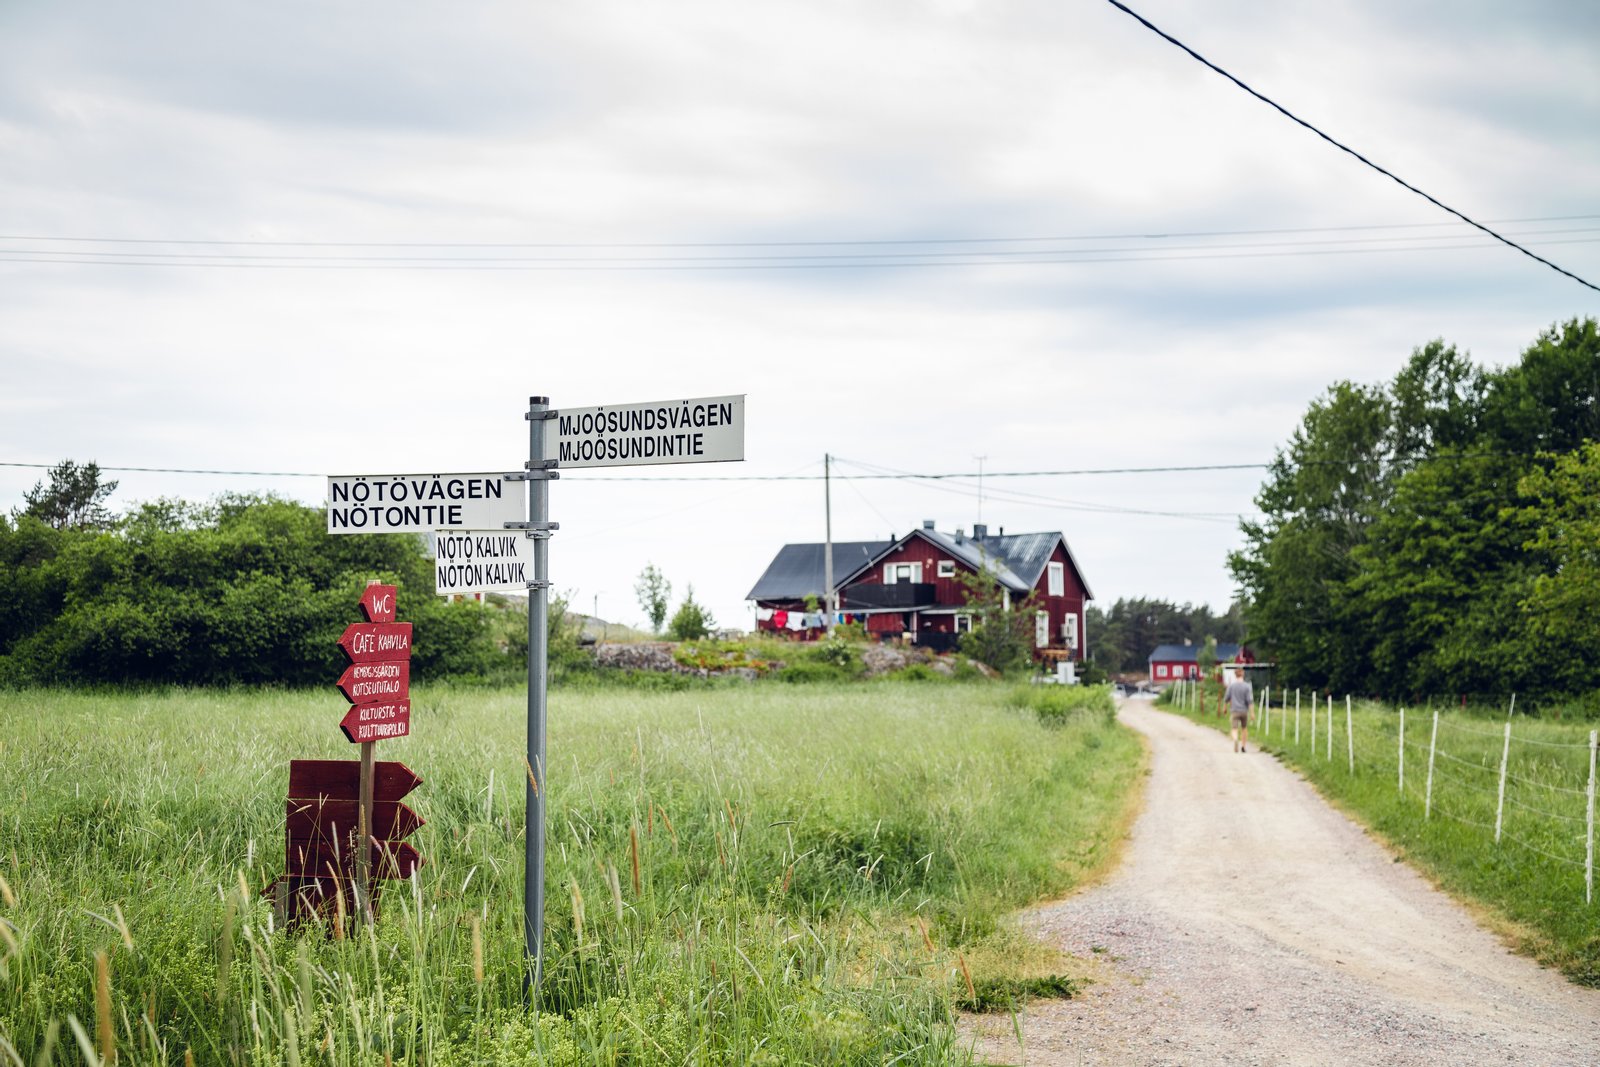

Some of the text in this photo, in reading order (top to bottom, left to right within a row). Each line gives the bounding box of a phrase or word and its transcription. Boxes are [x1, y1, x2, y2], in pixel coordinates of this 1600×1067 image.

[559, 400, 732, 436] MJOÖSUNDSVÄGEN
[559, 433, 704, 462] MJOÖSUNDINTIE
[332, 475, 502, 502] NÖTÖVÄGEN
[332, 503, 463, 528] NÖTONTIE
[437, 530, 517, 559] NÖTÖ KALVIK
[438, 559, 526, 588] NÖTÖN KALVIK
[373, 594, 391, 615] WC
[353, 627, 408, 654] CAFÉ KAHVILA
[359, 705, 396, 722] KULTURSTIG
